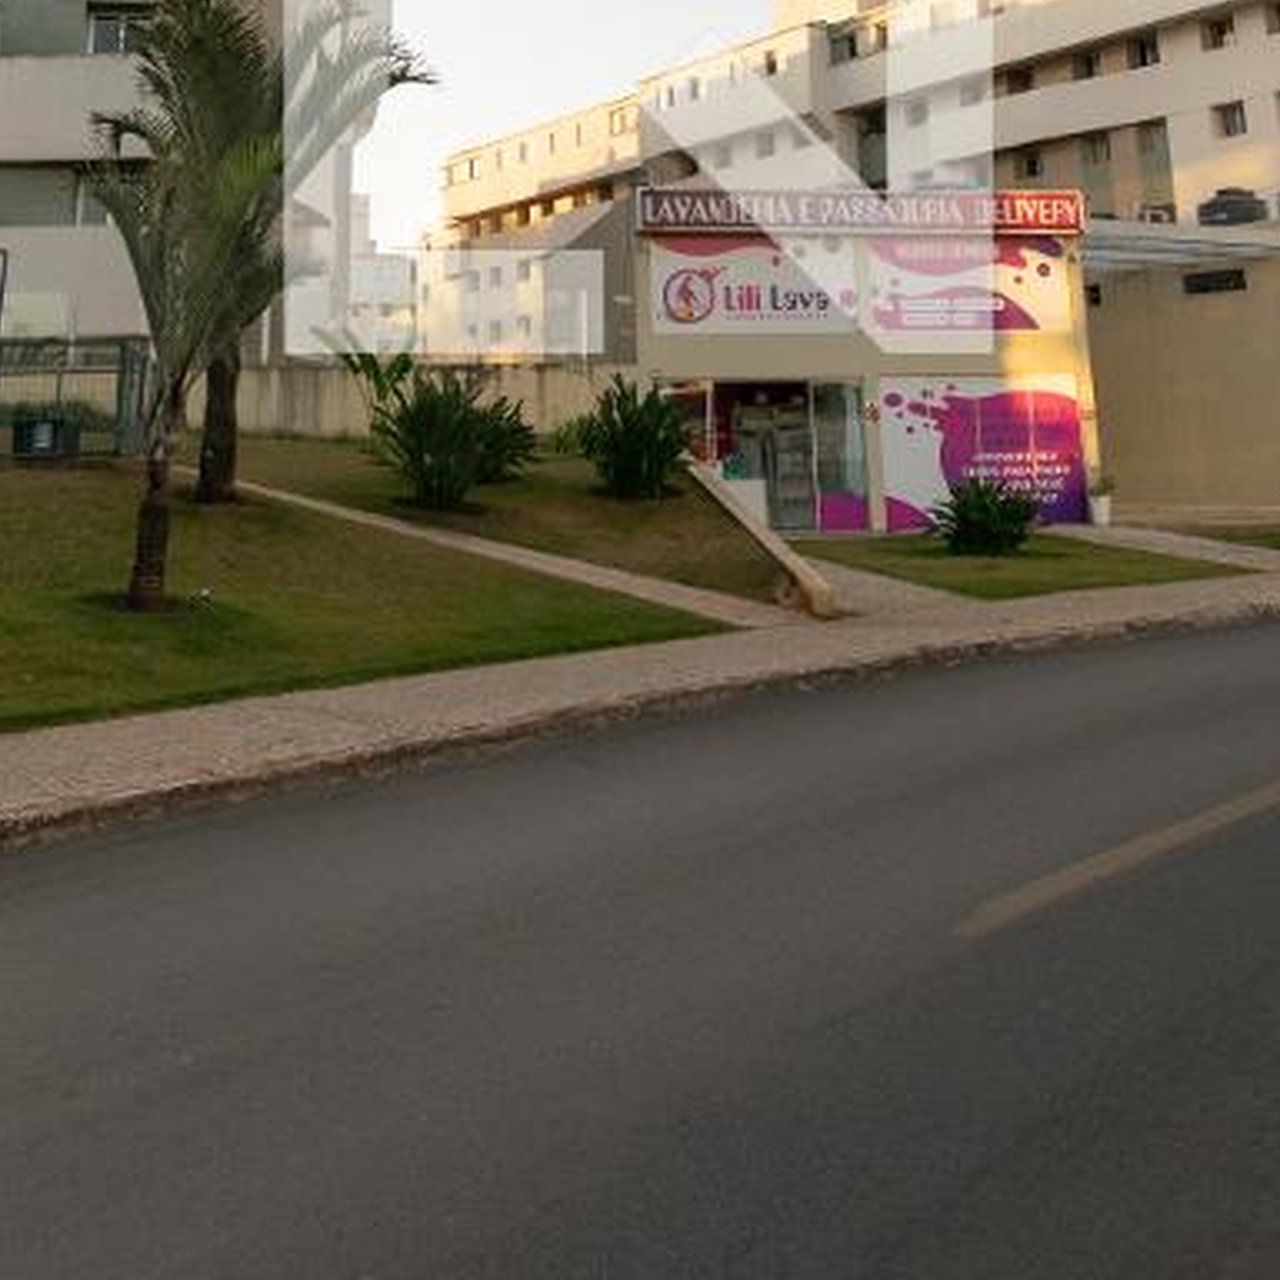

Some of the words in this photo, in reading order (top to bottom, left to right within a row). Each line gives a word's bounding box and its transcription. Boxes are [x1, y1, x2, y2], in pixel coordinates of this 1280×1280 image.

[643, 195, 794, 224] LAVANDERIA
[976, 195, 1079, 224] DELIVERY
[724, 282, 762, 312] Lili
[770, 284, 830, 312] Lava
